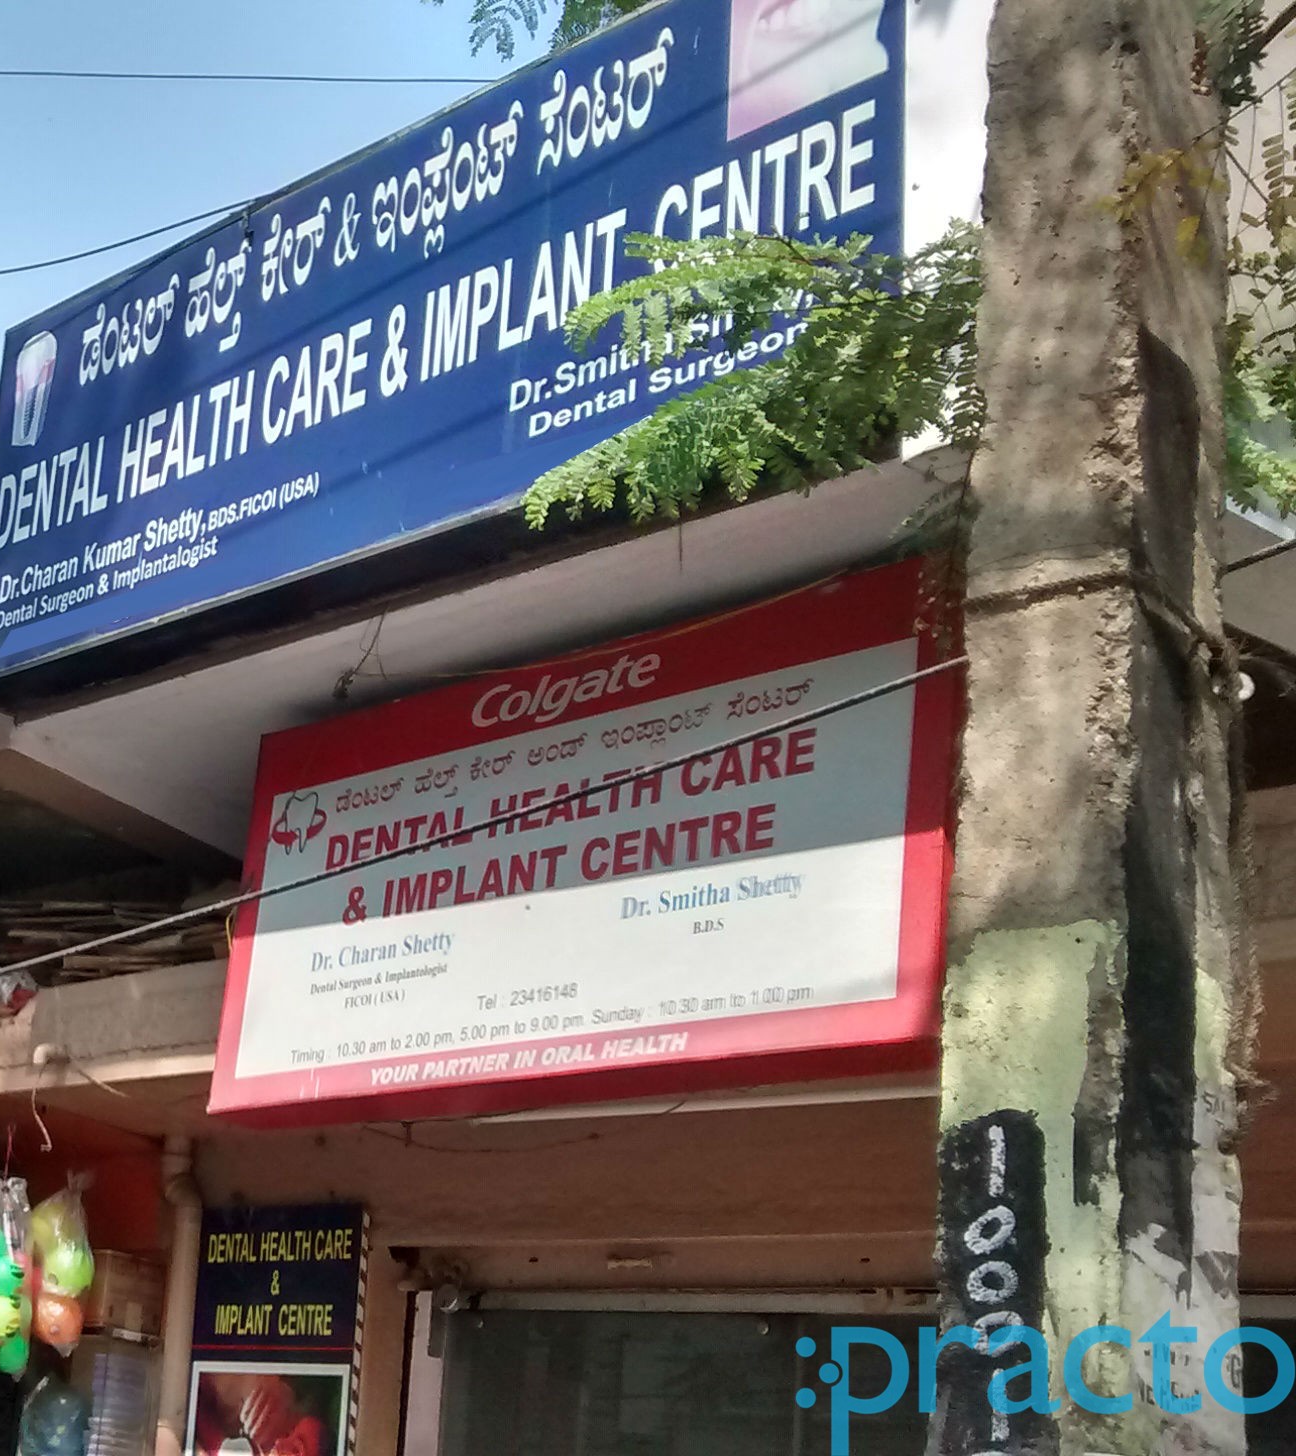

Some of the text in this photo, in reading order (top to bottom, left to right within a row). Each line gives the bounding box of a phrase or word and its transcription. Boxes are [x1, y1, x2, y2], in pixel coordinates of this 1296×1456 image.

[78, 273, 180, 387] ಡೆಂಟಲ್
[184, 246, 251, 352] ಹೆಲ್ತ್
[260, 196, 331, 302] ಕೇರ್
[334, 193, 361, 267] &
[536, 27, 674, 175] ಸೆಂಟರ್
[116, 369, 256, 503] HEALTH
[262, 319, 371, 443] CARE
[380, 304, 408, 392] &
[420, 208, 628, 384] IMPLANT
[654, 99, 876, 275] CENTRE
[528, 380, 636, 438] Dental
[0, 560, 78, 604] Dr.Charan
[83, 534, 140, 574] Kumar
[279, 471, 320, 511] (USA)
[39, 582, 94, 613] Surgeon
[97, 572, 109, 594] &
[112, 534, 219, 591] Implantalogist
[471, 653, 661, 728] Colgate
[335, 776, 404, 813] ಡೆಂಟಲ್
[470, 750, 516, 781] ಕೇರ್
[726, 678, 815, 720] ಸೆಂಟರ್
[325, 728, 817, 871] DENTAL HEALTH CARE
[342, 803, 776, 926] & IMPLANT CENTRE
[620, 896, 651, 920] Dr.
[658, 882, 730, 914] Smitha
[310, 931, 455, 973] Dr. Charan Shetty
[310, 979, 337, 995] Dental
[339, 974, 372, 991] Surgeon
[374, 972, 382, 985] &
[344, 993, 373, 1010] FICOI
[477, 994, 497, 1011] Tel
[510, 982, 578, 1007] 23416148
[290, 1045, 325, 1066] Timing
[336, 1040, 366, 1058] 10.30
[369, 1041, 387, 1055] am
[391, 1037, 402, 1052] to
[404, 1032, 430, 1049] 2.00
[460, 1025, 487, 1042] 5.00
[490, 1023, 511, 1041] pm
[514, 1019, 526, 1034] to
[591, 1004, 645, 1025] Sunday
[700, 994, 727, 1011] am
[370, 1031, 689, 1086] YOUR PARTNER IN ORAL HEALTH
[207, 1228, 353, 1264] DENTAL HEALTH CARE
[270, 1269, 280, 1296] &
[214, 1304, 334, 1337] IMPLANT CENTRE
